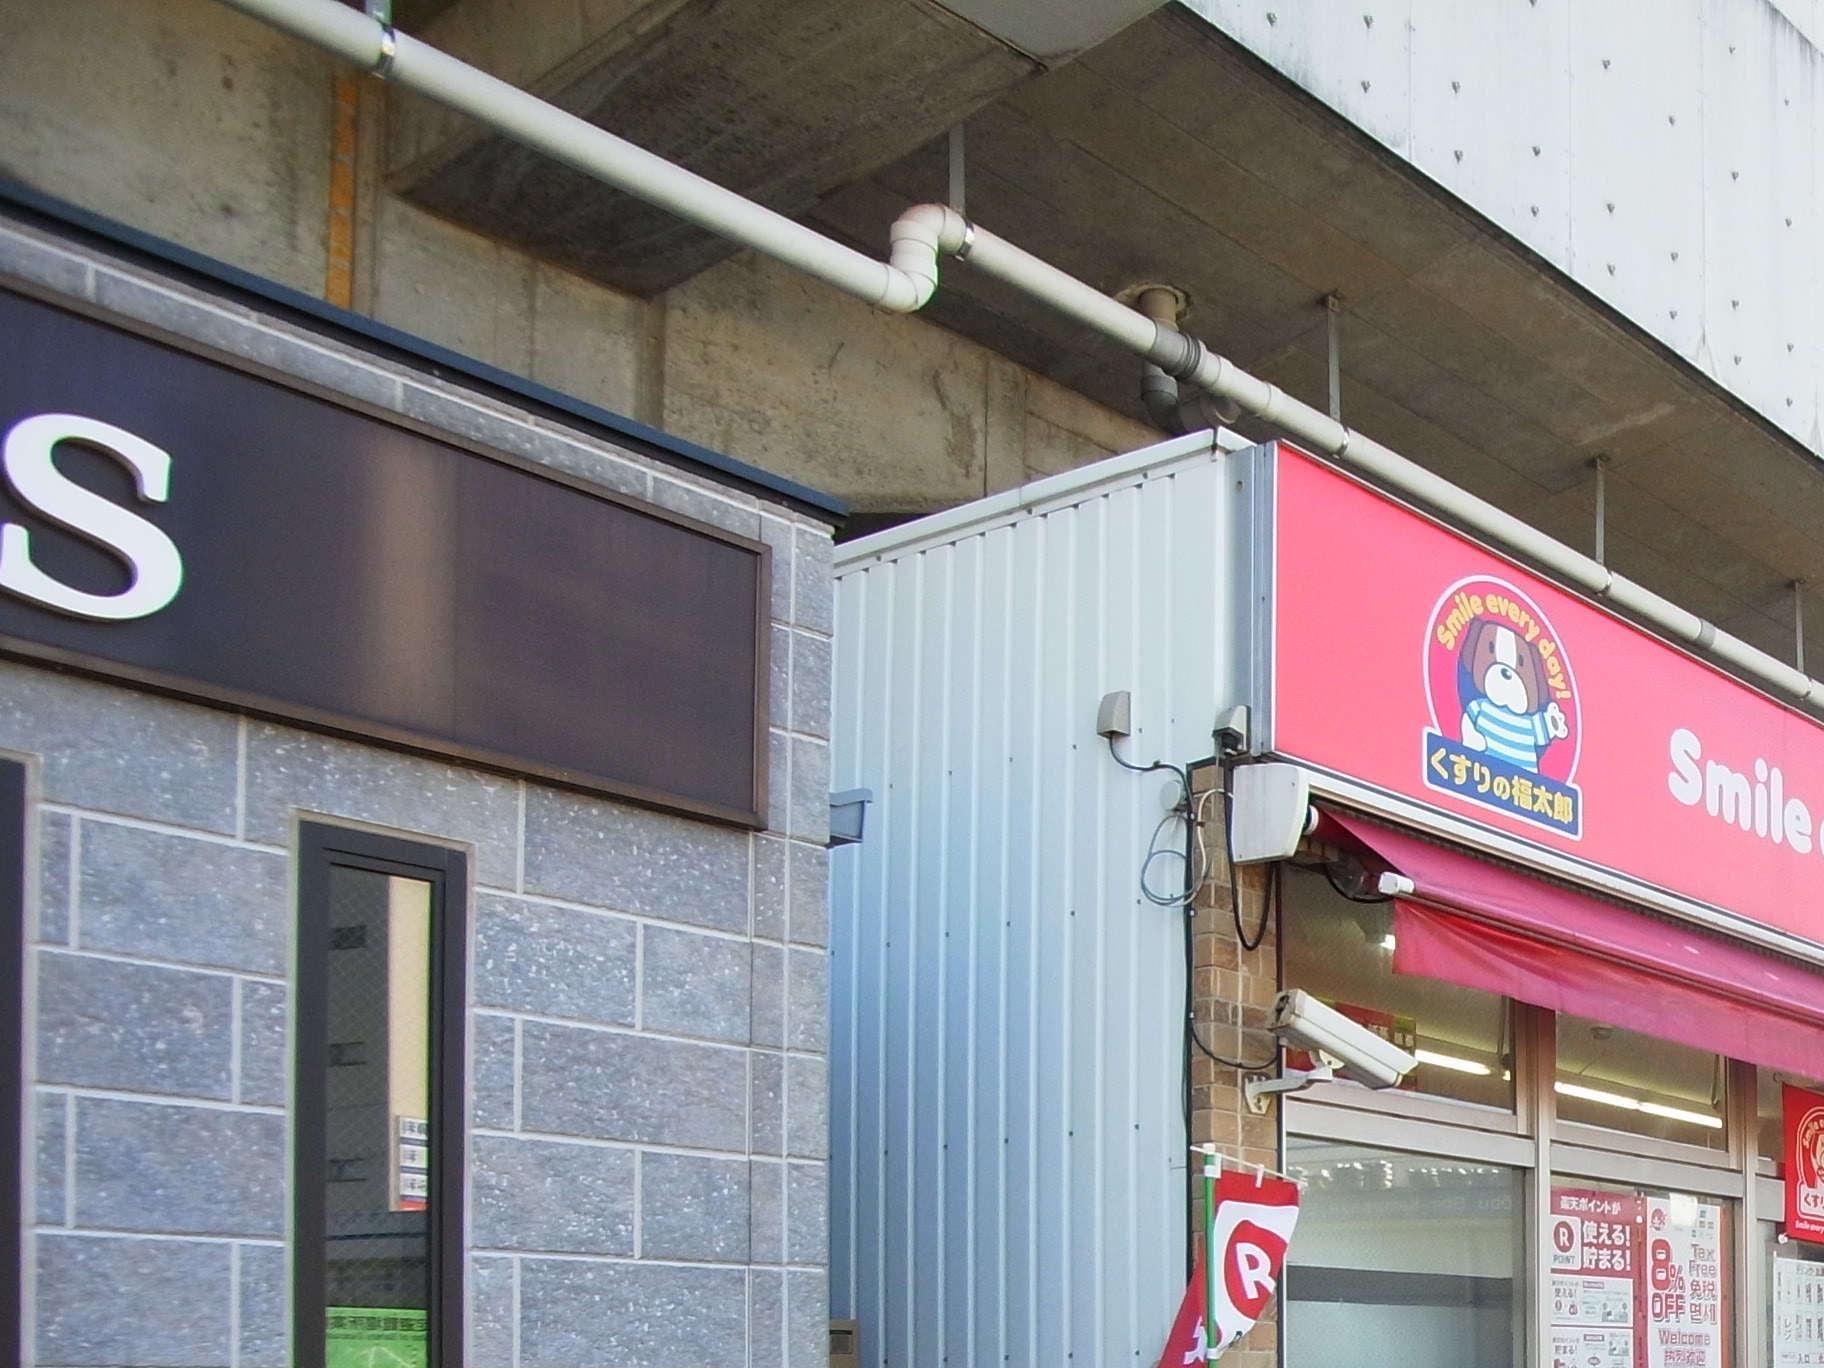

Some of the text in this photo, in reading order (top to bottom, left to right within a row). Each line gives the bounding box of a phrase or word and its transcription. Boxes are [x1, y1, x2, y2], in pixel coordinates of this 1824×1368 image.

[1436, 593, 1573, 701] Smile every day!
[1430, 747, 1575, 825] くすりの福太郎
[1668, 727, 1813, 854] Smile
[1560, 1195, 1621, 1216] 楽天ポイントが
[1582, 1219, 1631, 1248] 使える!
[1553, 1254, 1576, 1265] POINT
[1582, 1246, 1631, 1272] 貯まる!
[1690, 1243, 1715, 1262] Tax
[1688, 1259, 1718, 1279] Free
[1689, 1279, 1717, 1300] 免税
[1651, 1292, 1686, 1323] OFF
[1658, 1327, 1711, 1346] Welcome
